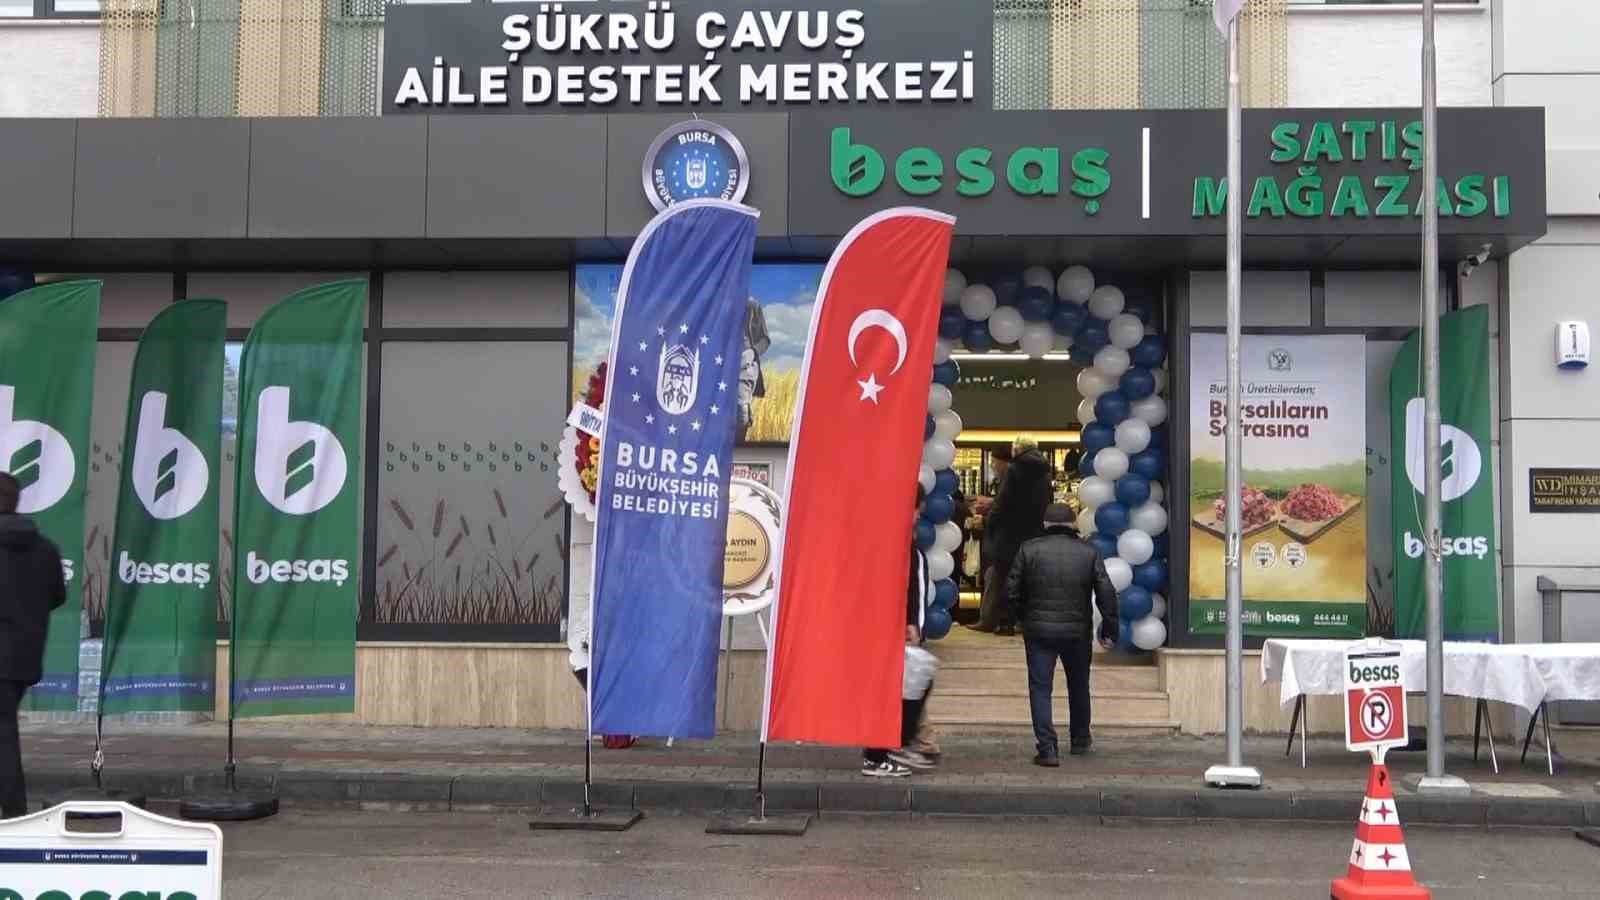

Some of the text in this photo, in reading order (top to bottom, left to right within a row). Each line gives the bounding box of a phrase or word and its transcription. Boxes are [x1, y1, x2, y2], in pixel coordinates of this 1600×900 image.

[501, 1, 865, 62] ŞÜKRÜ ÇAVUŞ
[395, 49, 975, 104] AİLE DESTEK MERKEZİ
[678, 131, 716, 146] BURSA
[1270, 121, 1424, 170] SATIŞ
[830, 127, 1111, 215] besaş
[1192, 165, 1511, 217] MAĞAZASI
[1209, 419, 1309, 437] Srasına
[617, 442, 720, 478] BURSA
[614, 469, 719, 499] BÜYÜKŞEHİR
[1536, 479, 1561, 490] WD
[612, 493, 718, 519] BELEDİYESİ
[1404, 531, 1488, 559] bsaş
[119, 550, 210, 589] besaş
[247, 551, 348, 587] besaş
[1349, 661, 1400, 684] besaş
